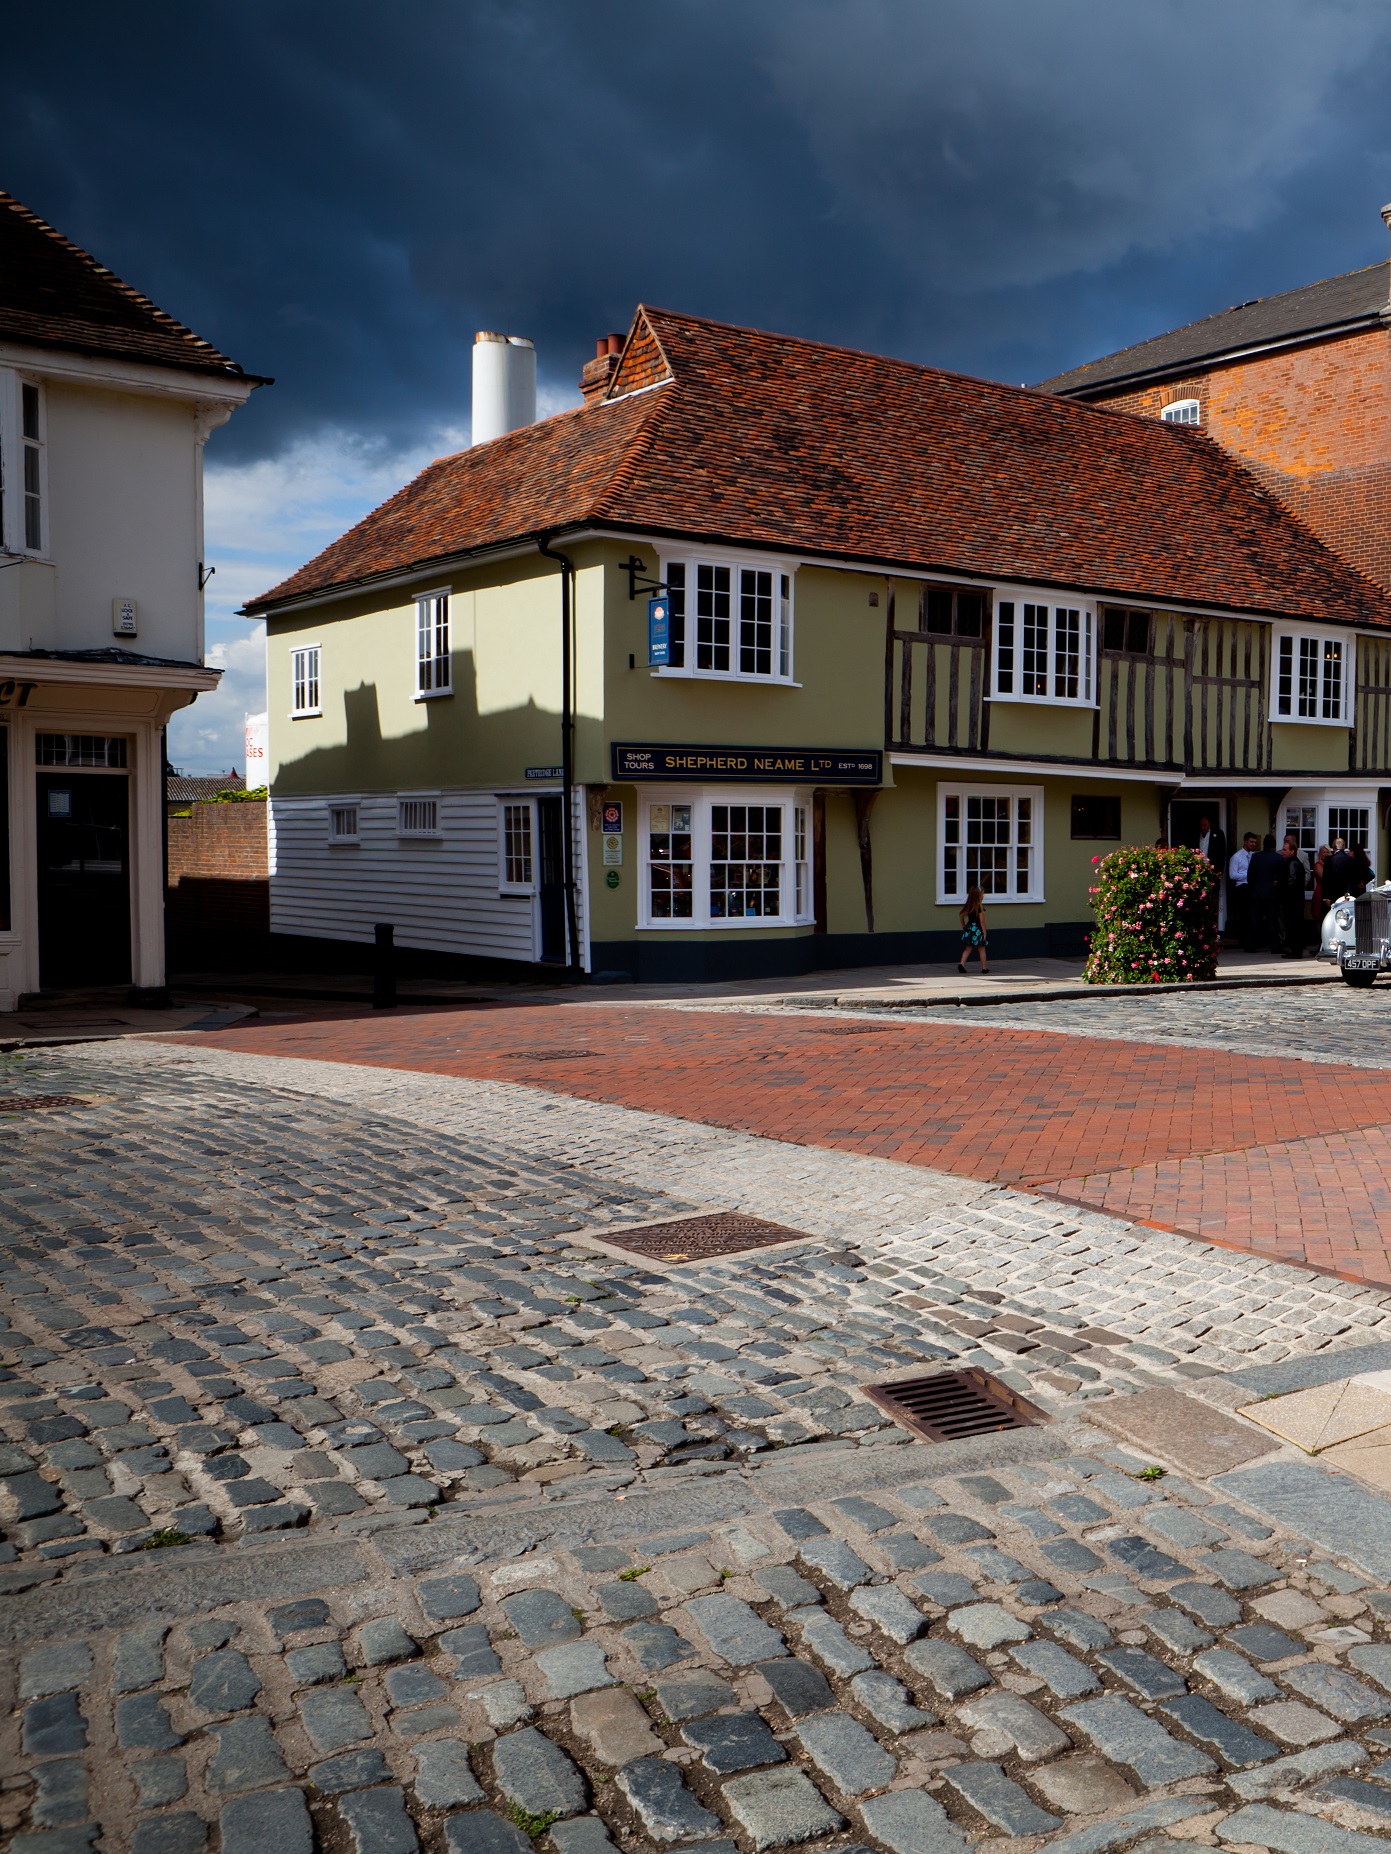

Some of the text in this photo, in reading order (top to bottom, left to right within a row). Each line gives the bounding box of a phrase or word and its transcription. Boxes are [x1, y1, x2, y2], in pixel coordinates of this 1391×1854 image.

[624, 761, 654, 769] TOURS
[665, 756, 747, 769] SHEPHERD
[754, 759, 805, 771] NEAME
[1347, 960, 1361, 968] 457
